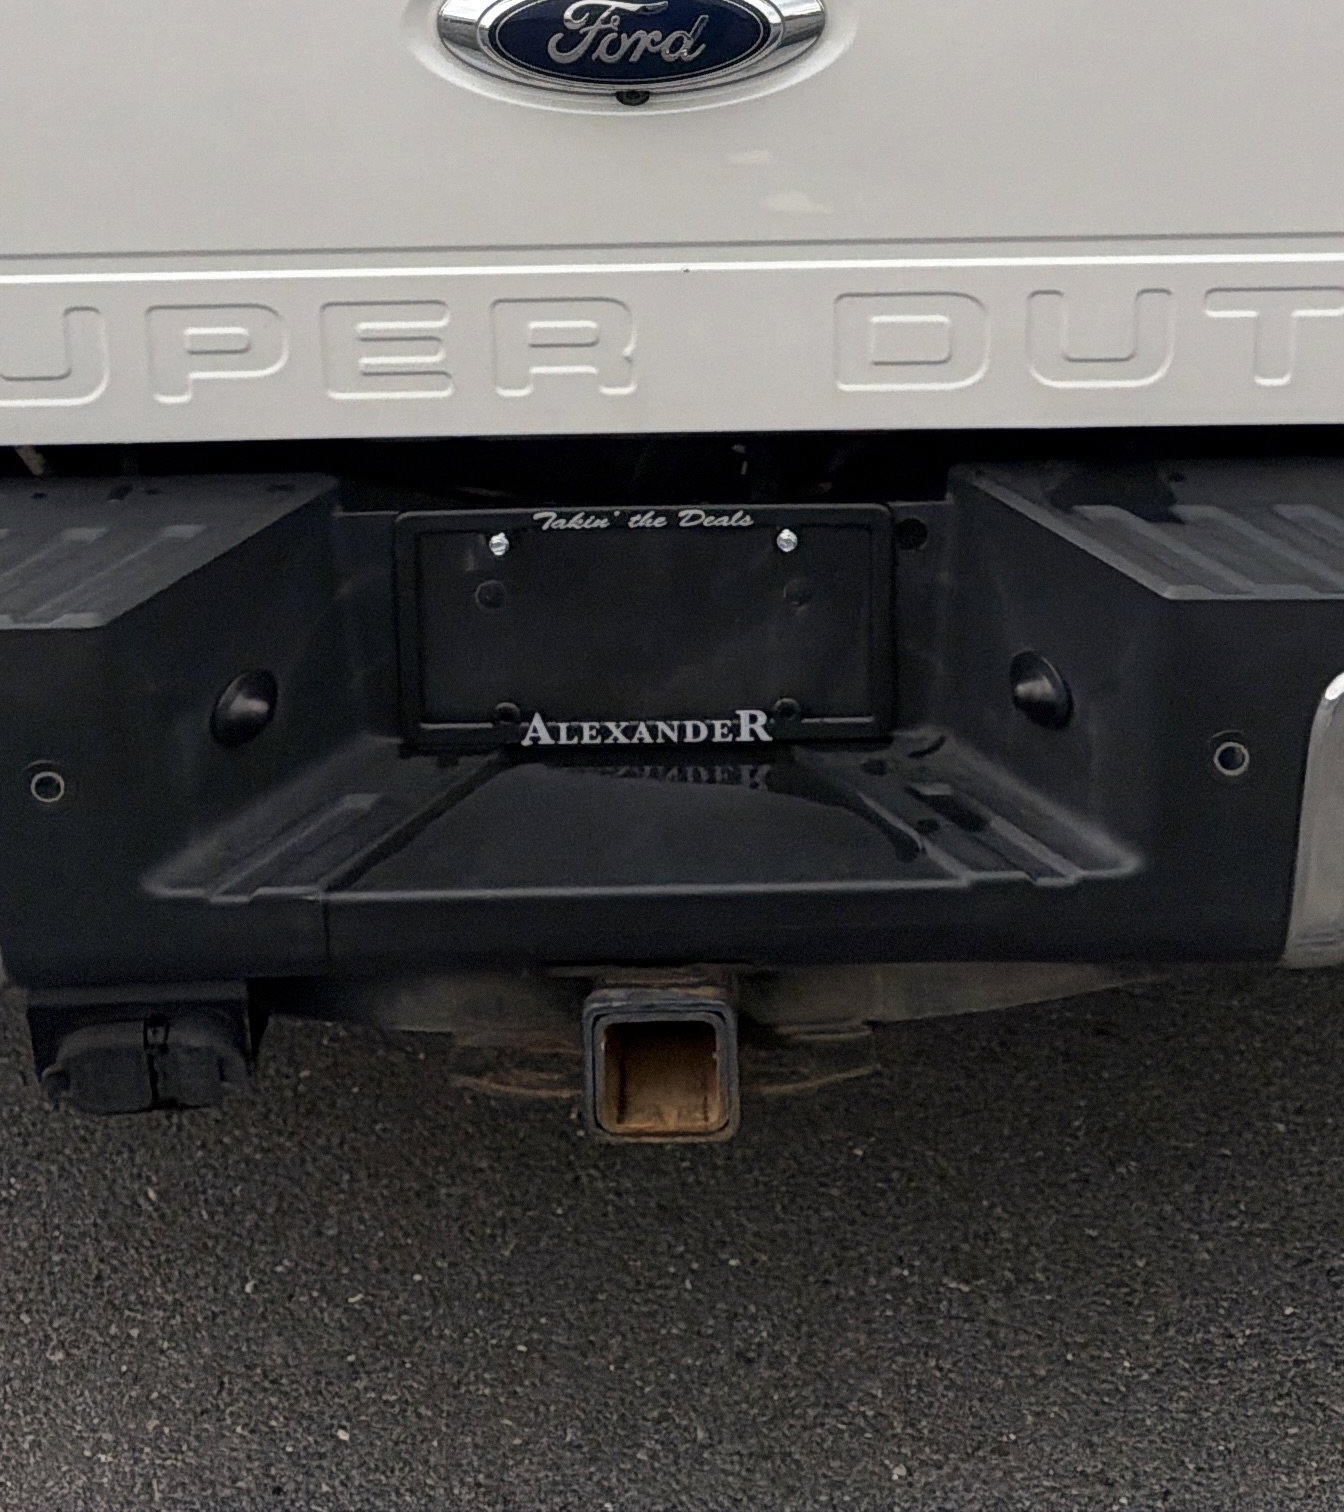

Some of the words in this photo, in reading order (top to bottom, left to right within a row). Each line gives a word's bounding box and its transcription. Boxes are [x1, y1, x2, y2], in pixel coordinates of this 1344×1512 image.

[548, 0, 709, 64] Ford
[533, 511, 619, 530] Takin'
[627, 511, 667, 528] the
[677, 509, 754, 528] Deals
